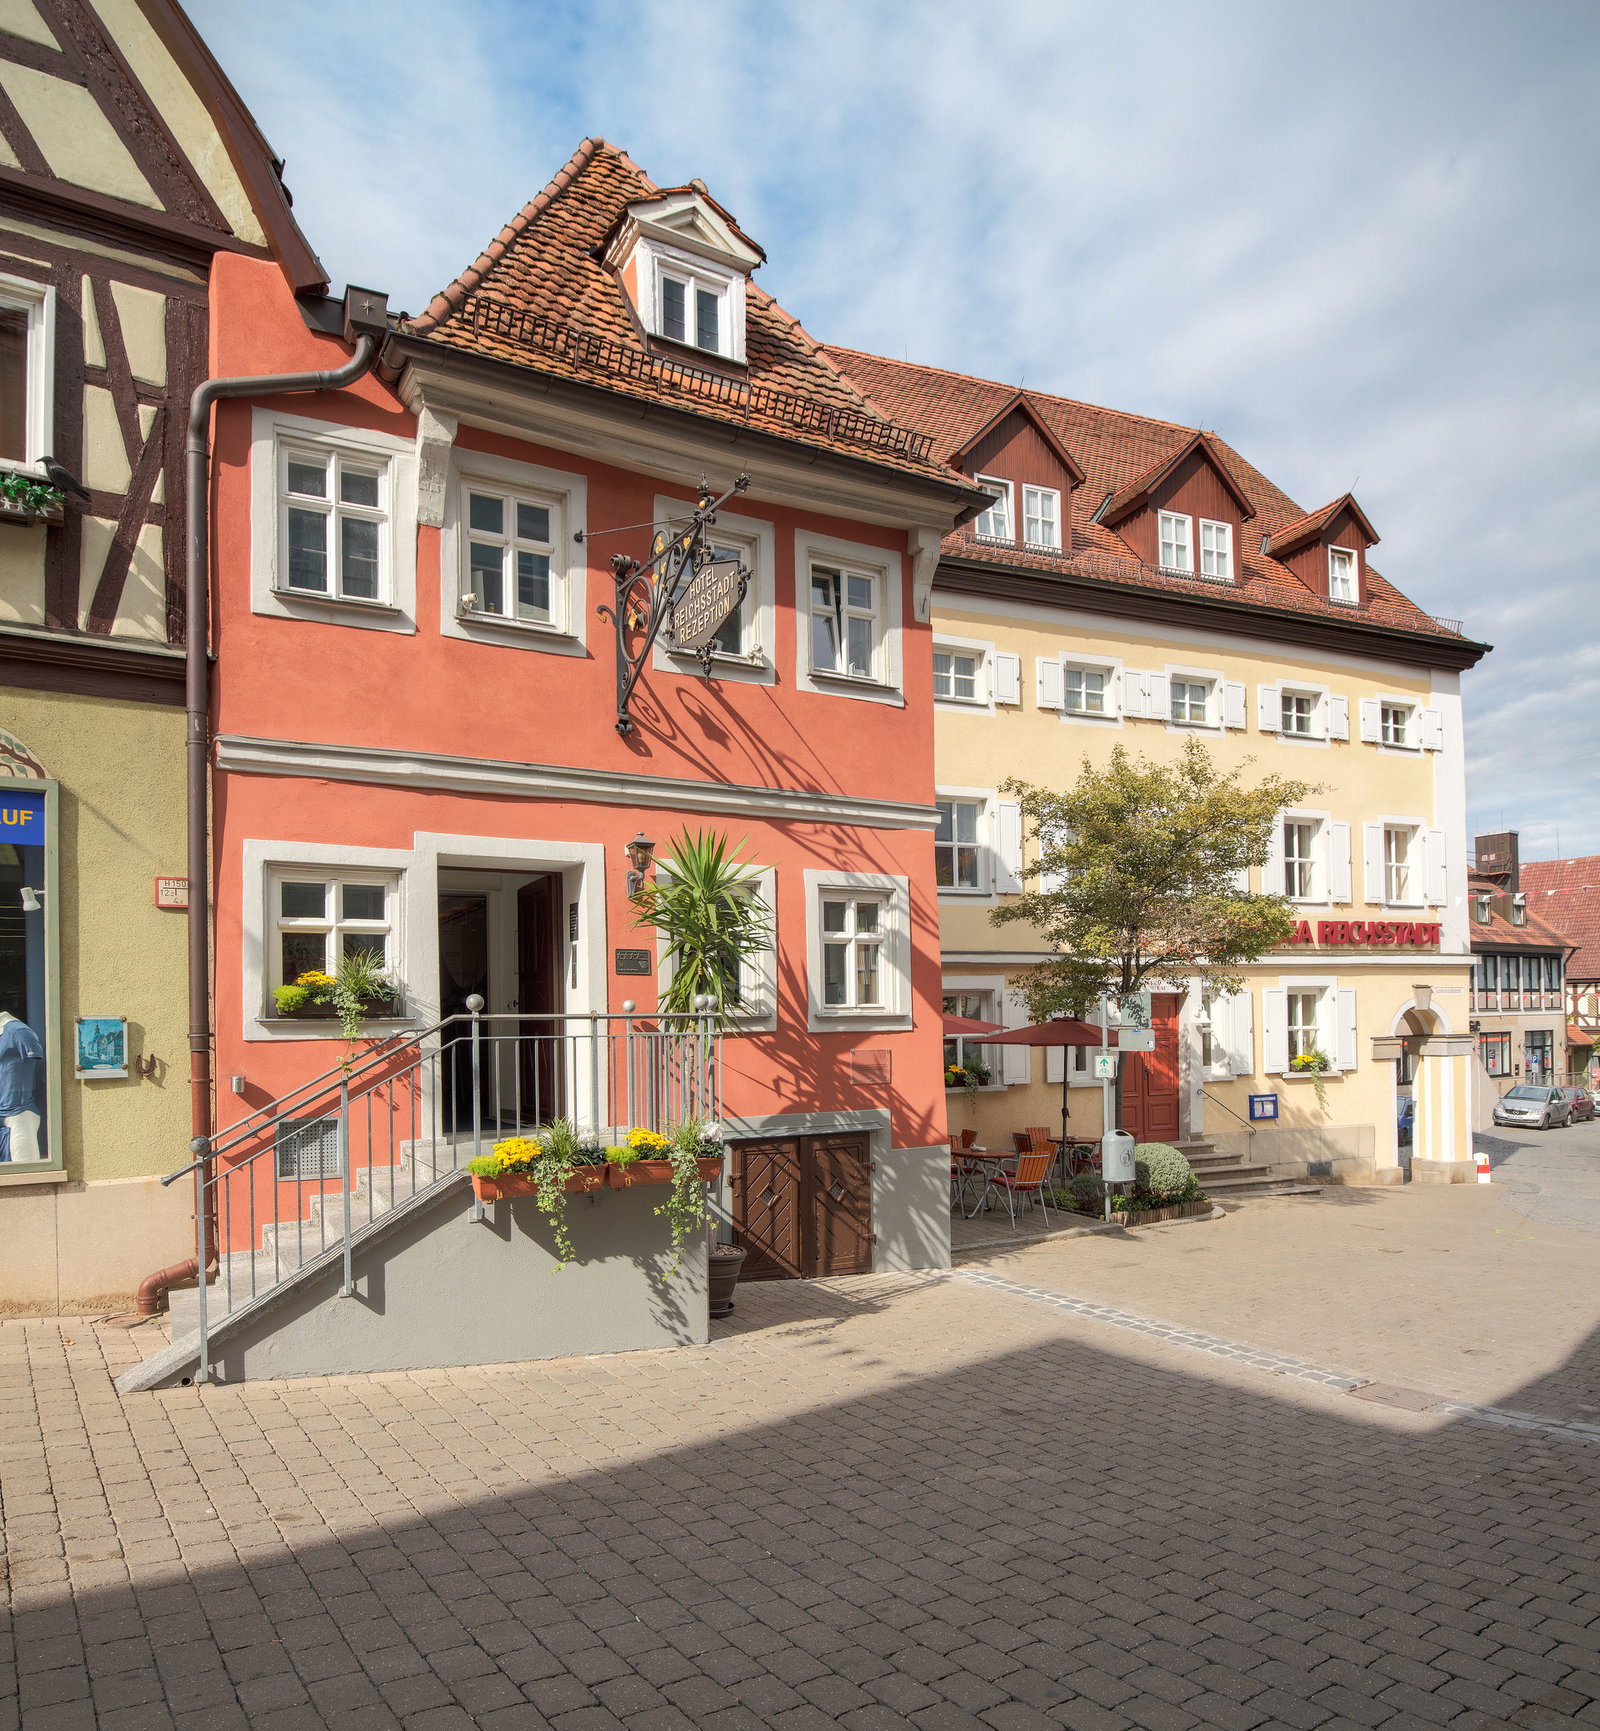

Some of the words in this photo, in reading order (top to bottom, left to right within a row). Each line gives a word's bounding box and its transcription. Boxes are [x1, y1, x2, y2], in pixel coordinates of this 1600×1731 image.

[689, 567, 718, 600] HOTEL
[674, 571, 736, 630] REICHSSTADT
[680, 595, 731, 644] REZEPTION
[0, 808, 33, 826] UF
[1317, 920, 1443, 945] REICHSSTADT
